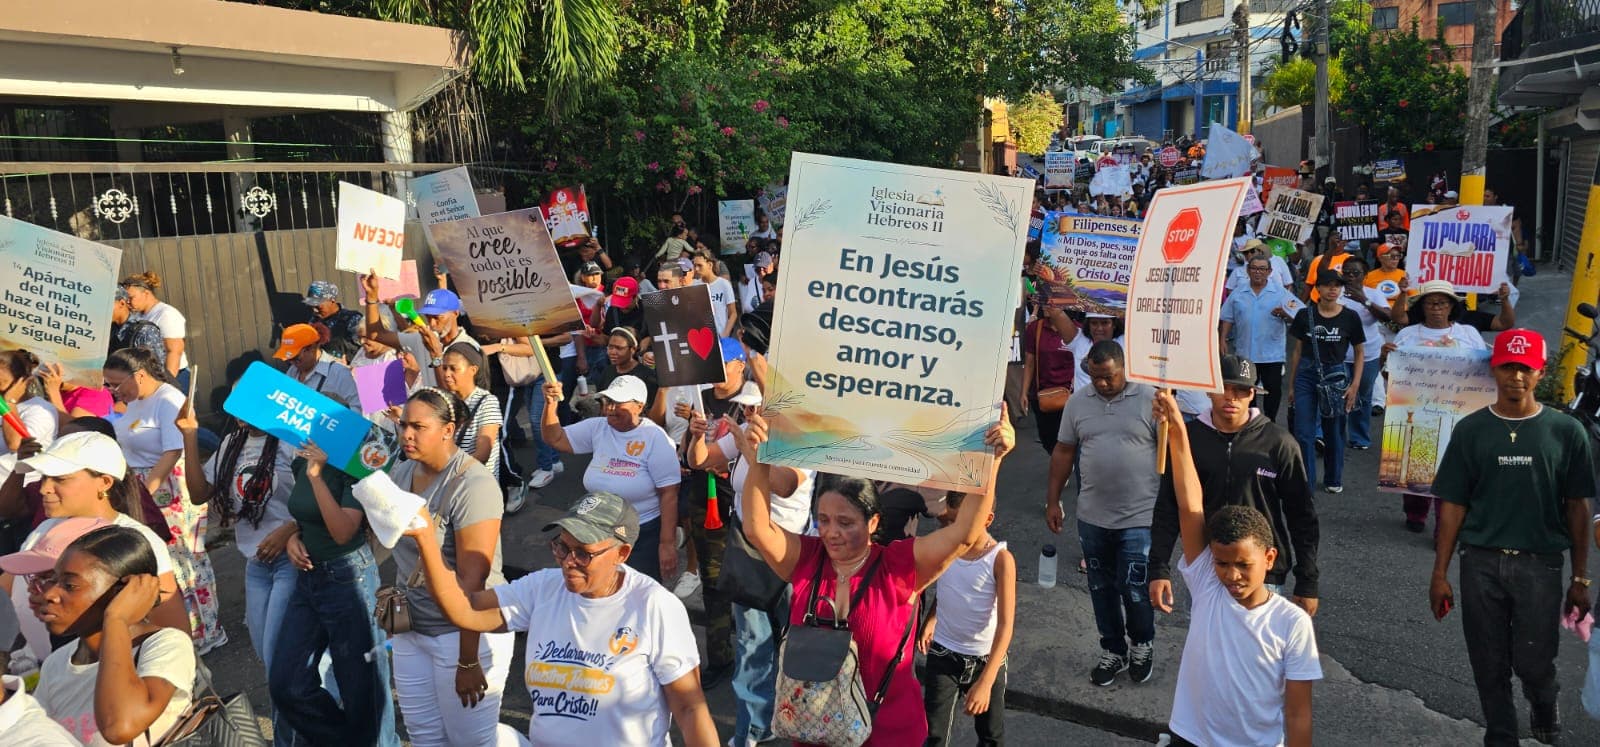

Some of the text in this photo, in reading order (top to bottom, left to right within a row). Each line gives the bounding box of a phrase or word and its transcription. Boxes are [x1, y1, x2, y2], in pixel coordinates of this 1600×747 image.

[871, 186, 914, 203] Iglesia
[1274, 194, 1313, 218] PALABRA
[870, 200, 944, 220] Visionaria
[354, 222, 403, 248] OCEAN
[467, 224, 504, 239] Al que
[867, 213, 943, 233] Hebreos II
[1073, 219, 1127, 233] Filipenses
[1268, 219, 1302, 242] LIBERTA
[469, 236, 521, 259] cree,
[1077, 237, 1098, 249] Dios,
[1100, 242, 1120, 251] pues,
[1168, 228, 1194, 243] STOP
[1423, 222, 1497, 251] TU PALABRA
[471, 257, 533, 272] todo le es
[840, 248, 959, 284] En Jesús
[1057, 256, 1072, 265] sus
[1076, 256, 1117, 270] riquezas
[1100, 250, 1116, 259] falta
[23, 266, 92, 294] Apártate
[1076, 267, 1110, 280] Cristo
[1146, 267, 1201, 285] JESUS QUIERE
[1418, 251, 1494, 287] ES VERDAD
[20, 281, 81, 308] del mal,
[808, 279, 984, 318] encontrarás
[1136, 298, 1161, 313] DARLE
[1196, 299, 1203, 315] A
[5, 290, 92, 326] haz el bien,
[0, 304, 96, 341] Busca la paz,
[819, 307, 964, 351] descanso,
[8, 322, 80, 350] y síguela.
[1152, 329, 1180, 345] TU VIDA
[836, 345, 938, 378] amor y
[805, 370, 961, 408] esperanza.
[266, 389, 339, 432] JESUS TE
[276, 410, 312, 435] AMA
[540, 640, 606, 666] Declaramos
[532, 690, 599, 716] Para Cristo!!
